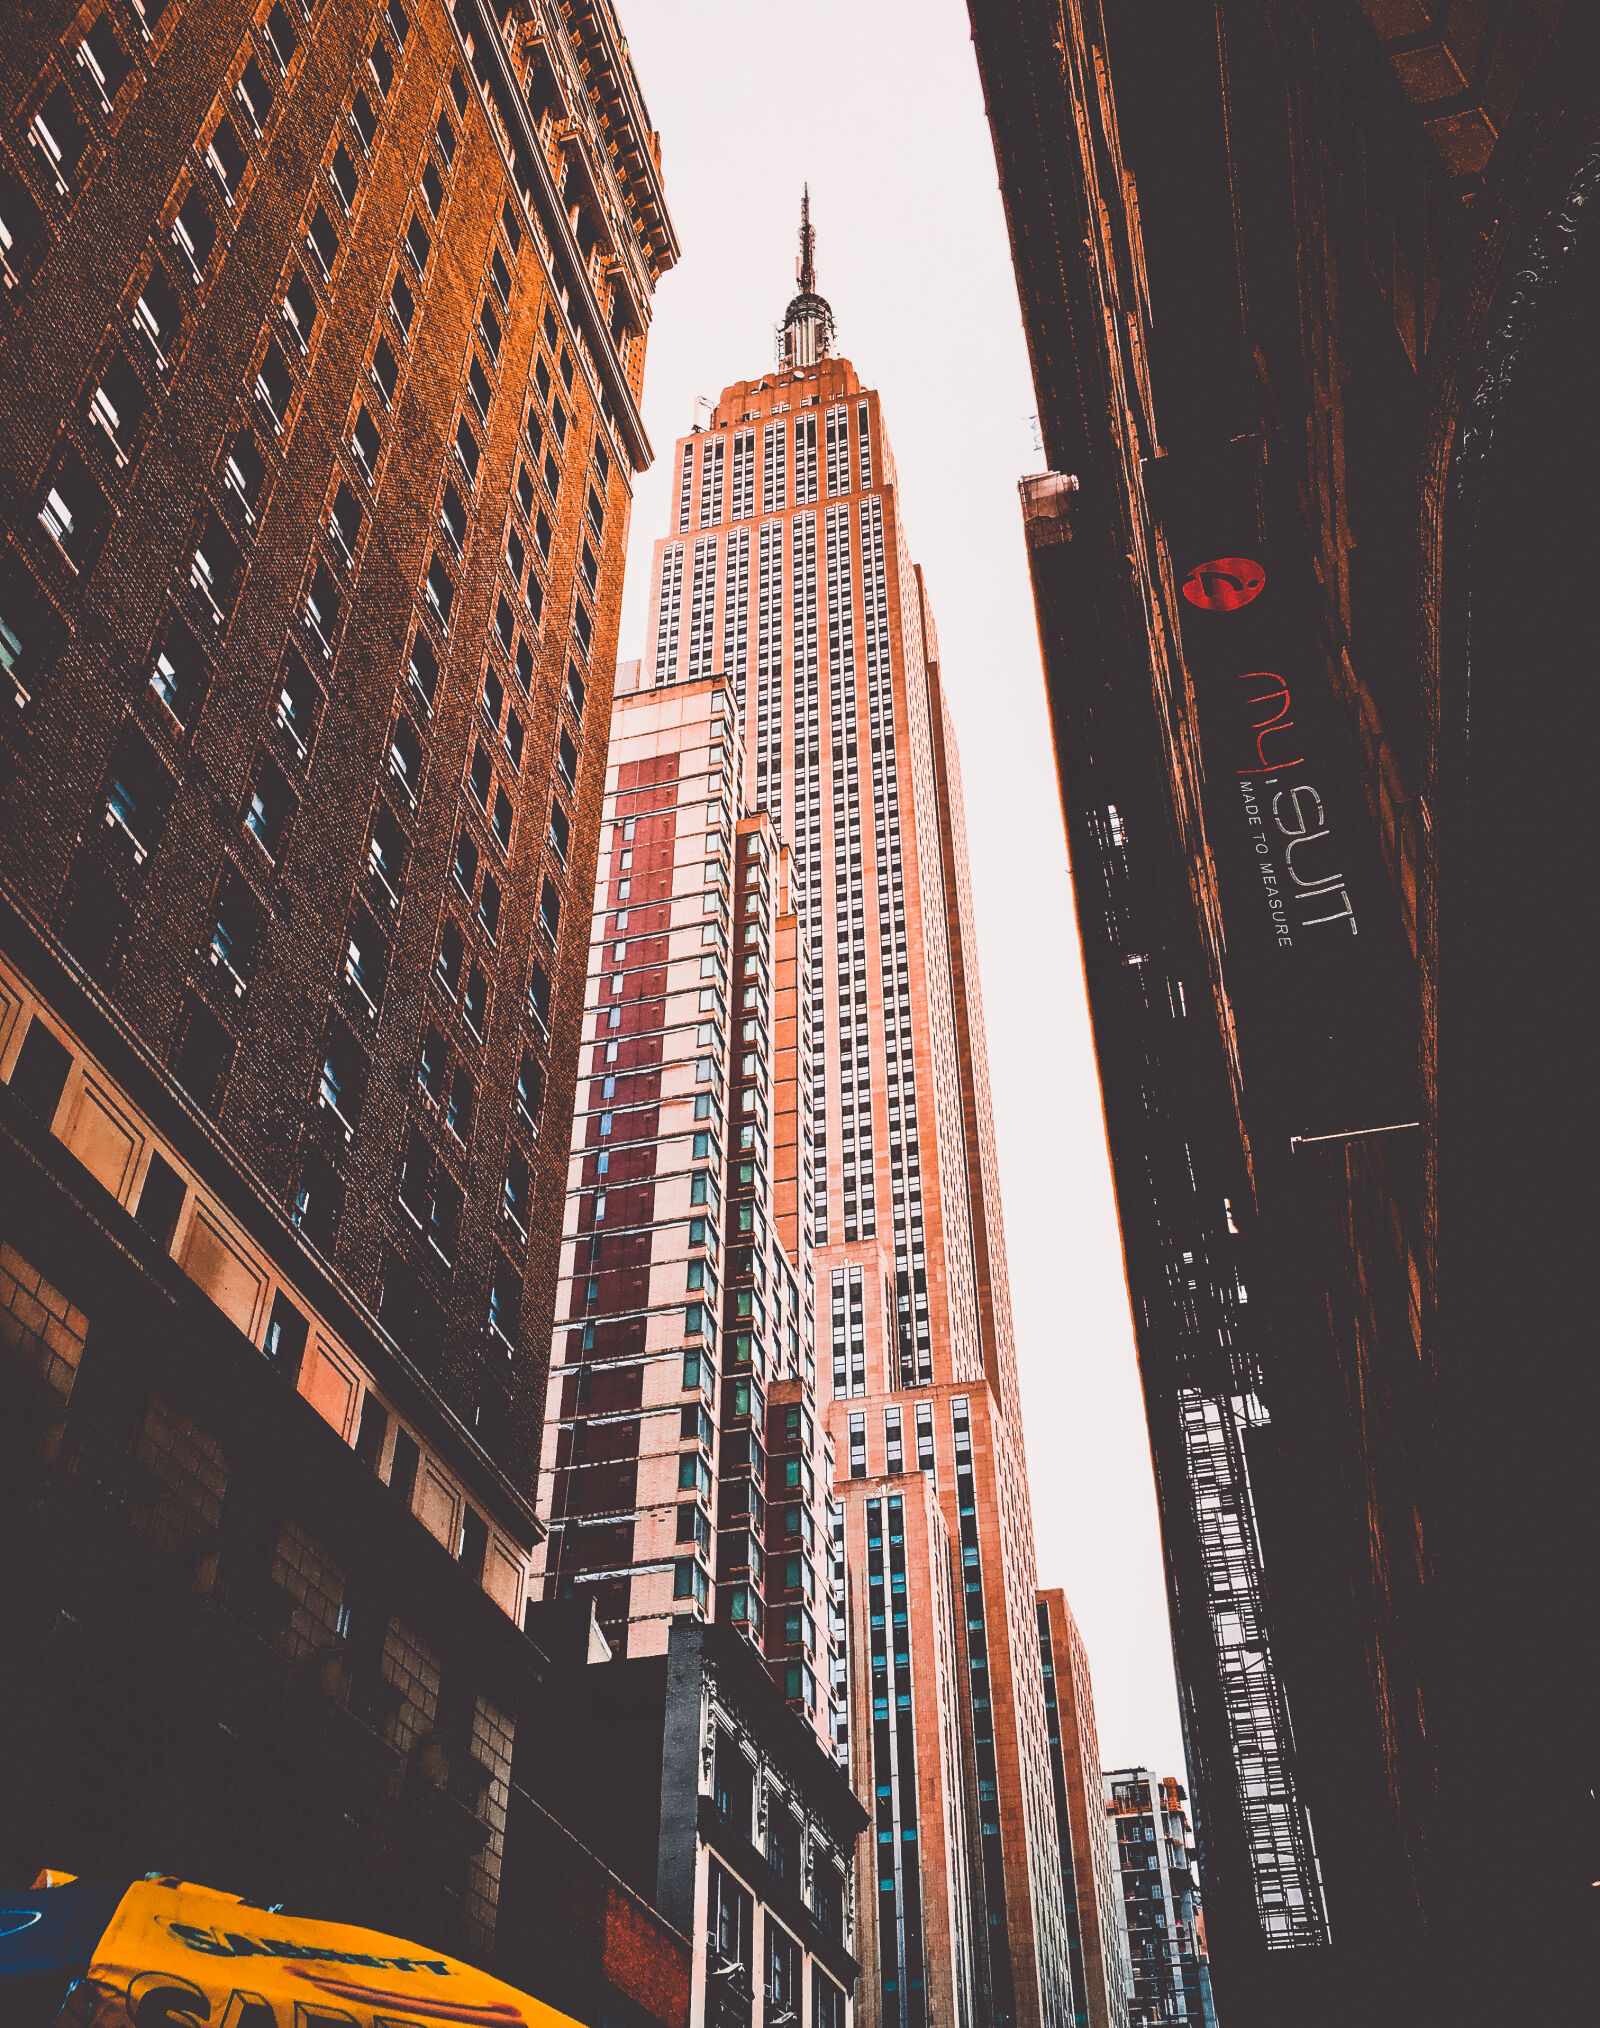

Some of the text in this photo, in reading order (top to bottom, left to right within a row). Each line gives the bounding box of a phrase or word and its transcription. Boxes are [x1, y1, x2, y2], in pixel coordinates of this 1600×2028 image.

[1239, 781, 1293, 947] MADE TO MEASURE
